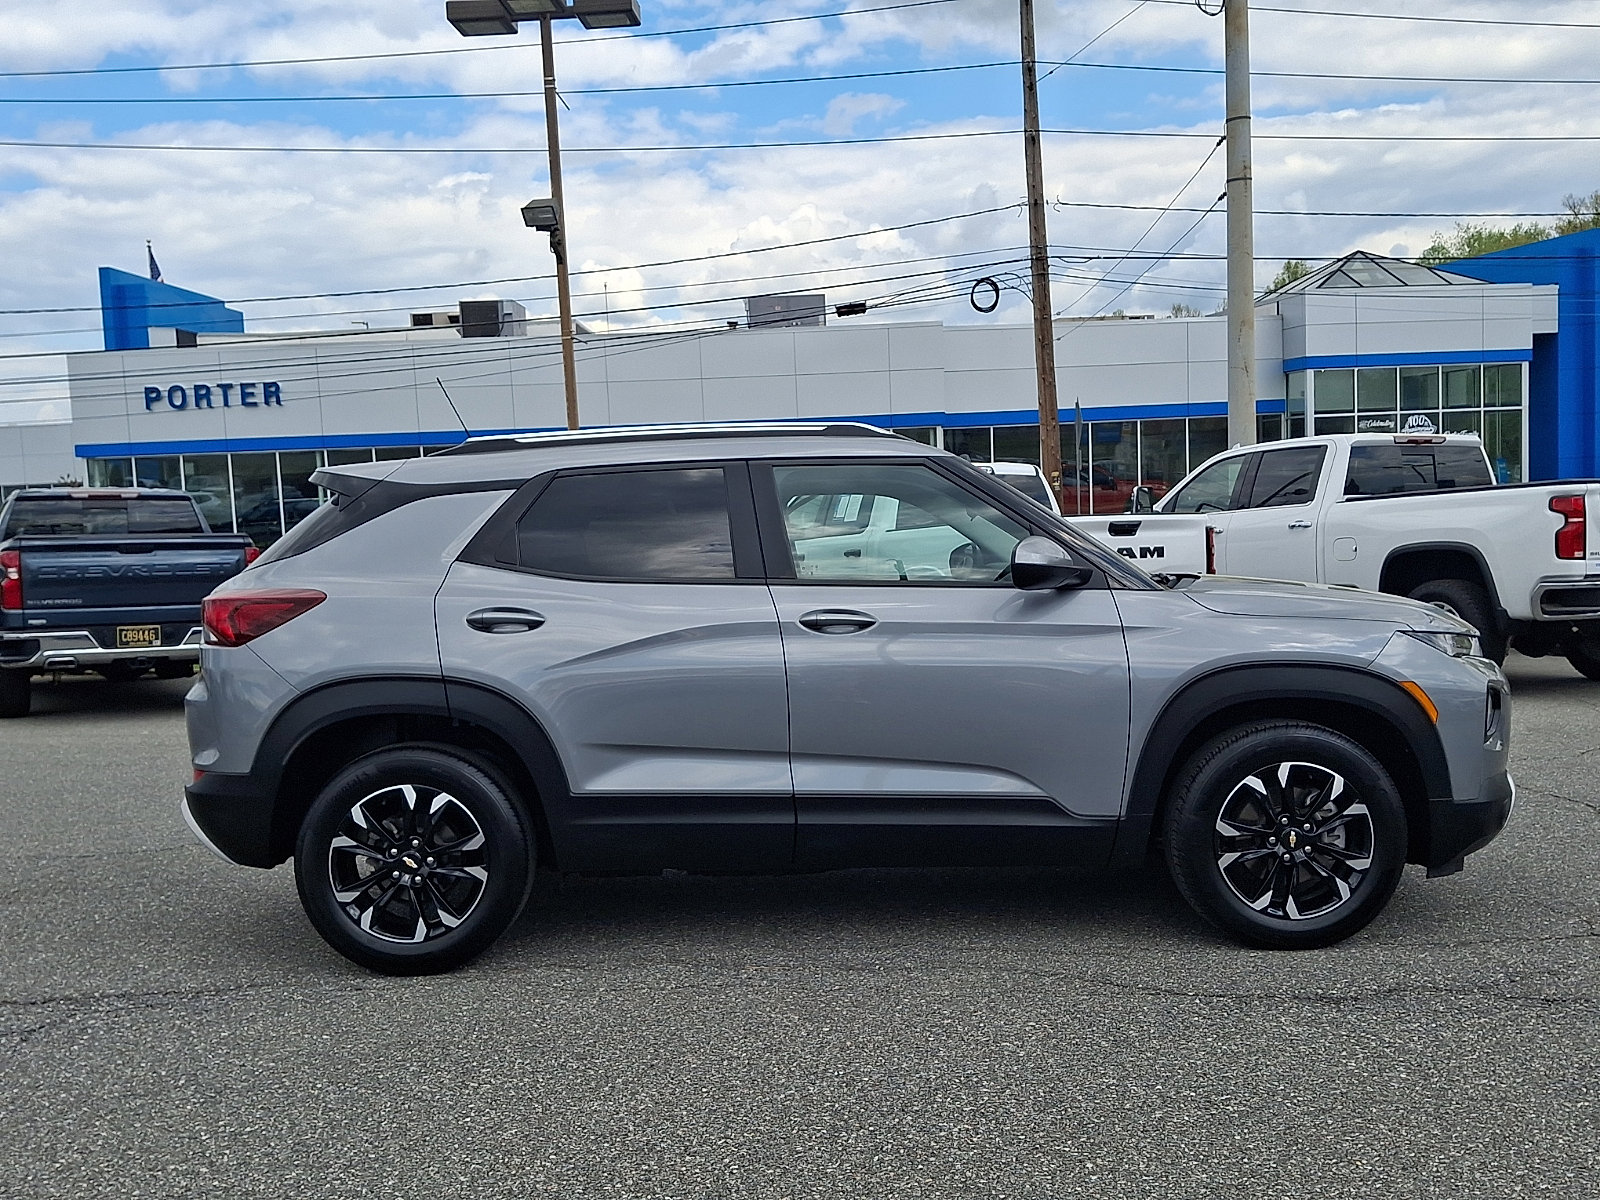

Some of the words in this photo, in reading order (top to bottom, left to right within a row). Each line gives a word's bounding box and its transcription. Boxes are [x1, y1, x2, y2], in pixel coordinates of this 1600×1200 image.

[144, 381, 282, 410] PORTER
[1116, 546, 1165, 559] AM
[38, 563, 231, 578] CHEVROLET
